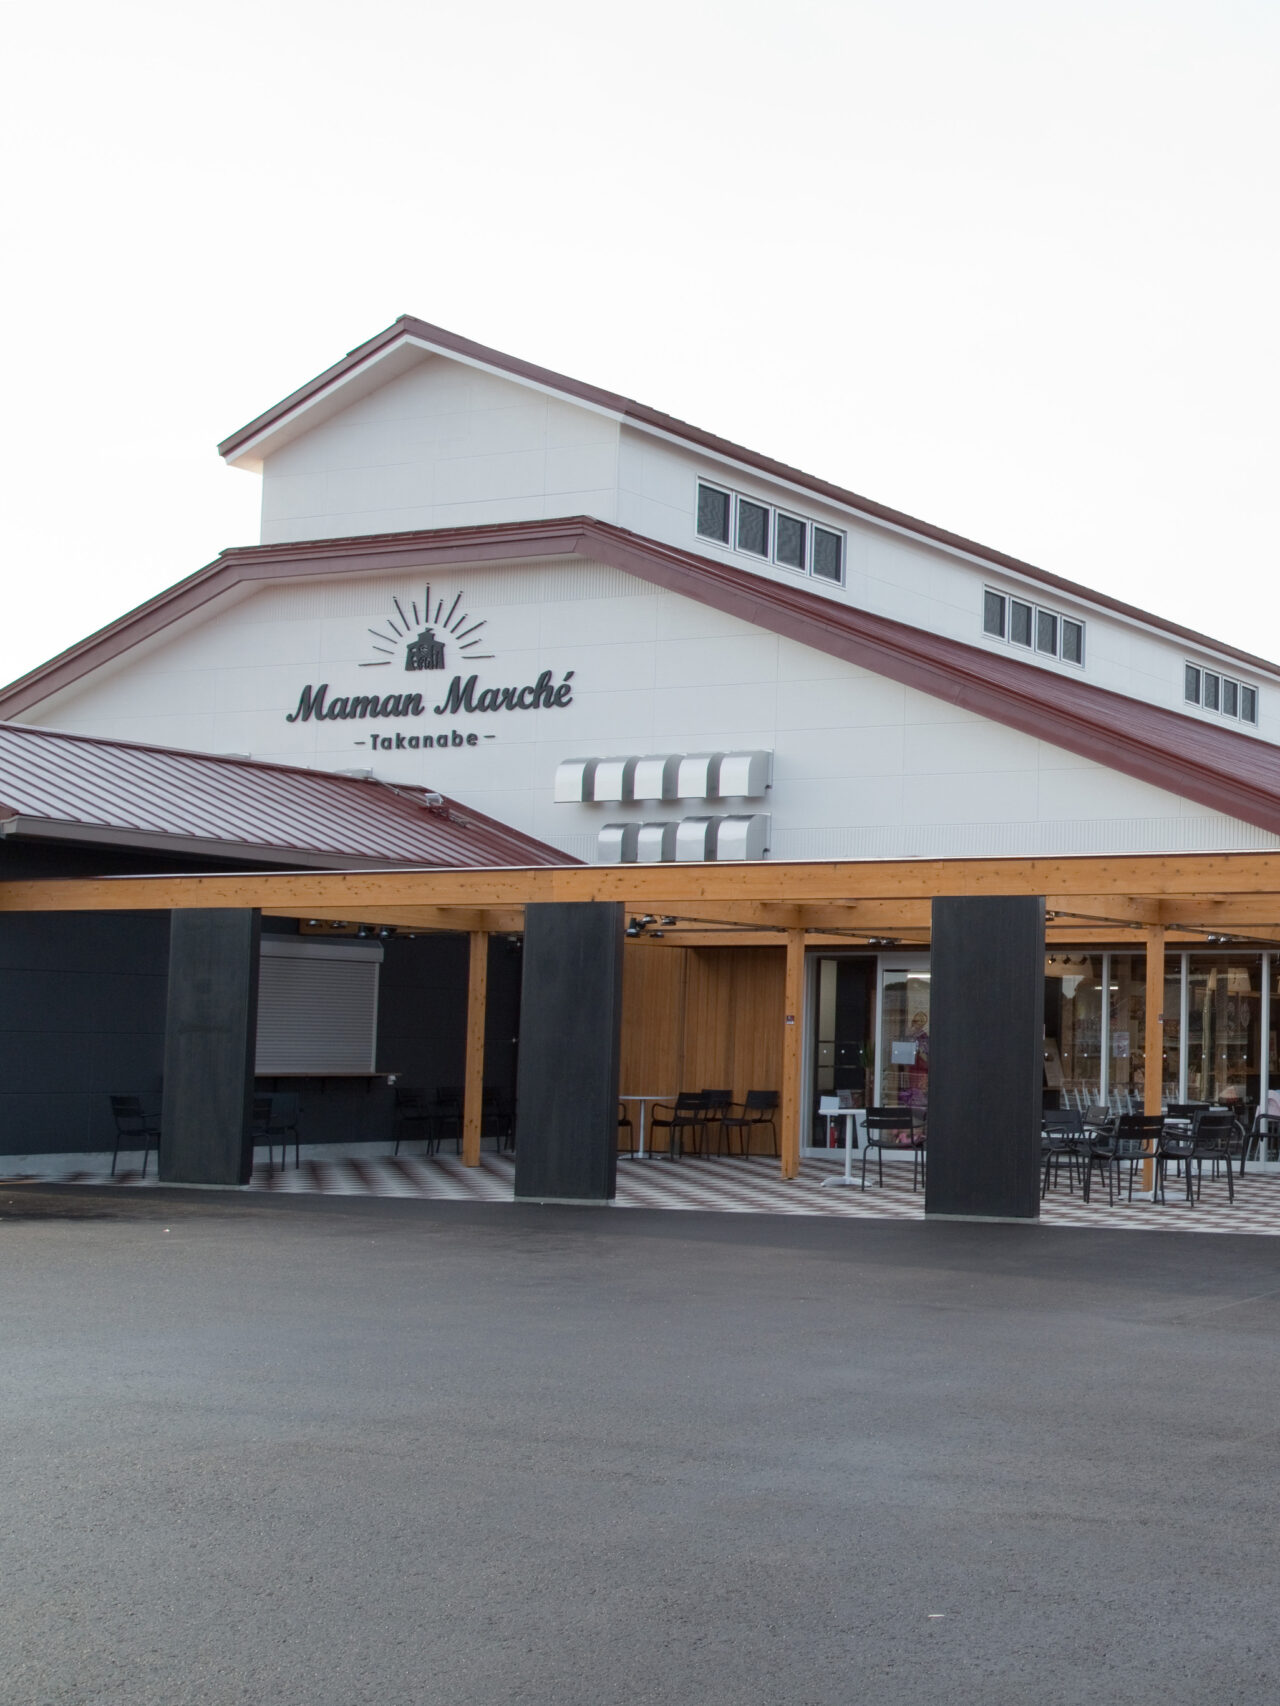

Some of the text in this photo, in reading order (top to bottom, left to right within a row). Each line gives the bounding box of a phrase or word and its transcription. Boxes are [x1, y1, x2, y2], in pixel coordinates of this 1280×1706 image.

[285, 669, 576, 723] Maman Marché
[370, 730, 479, 751] Takanabe
